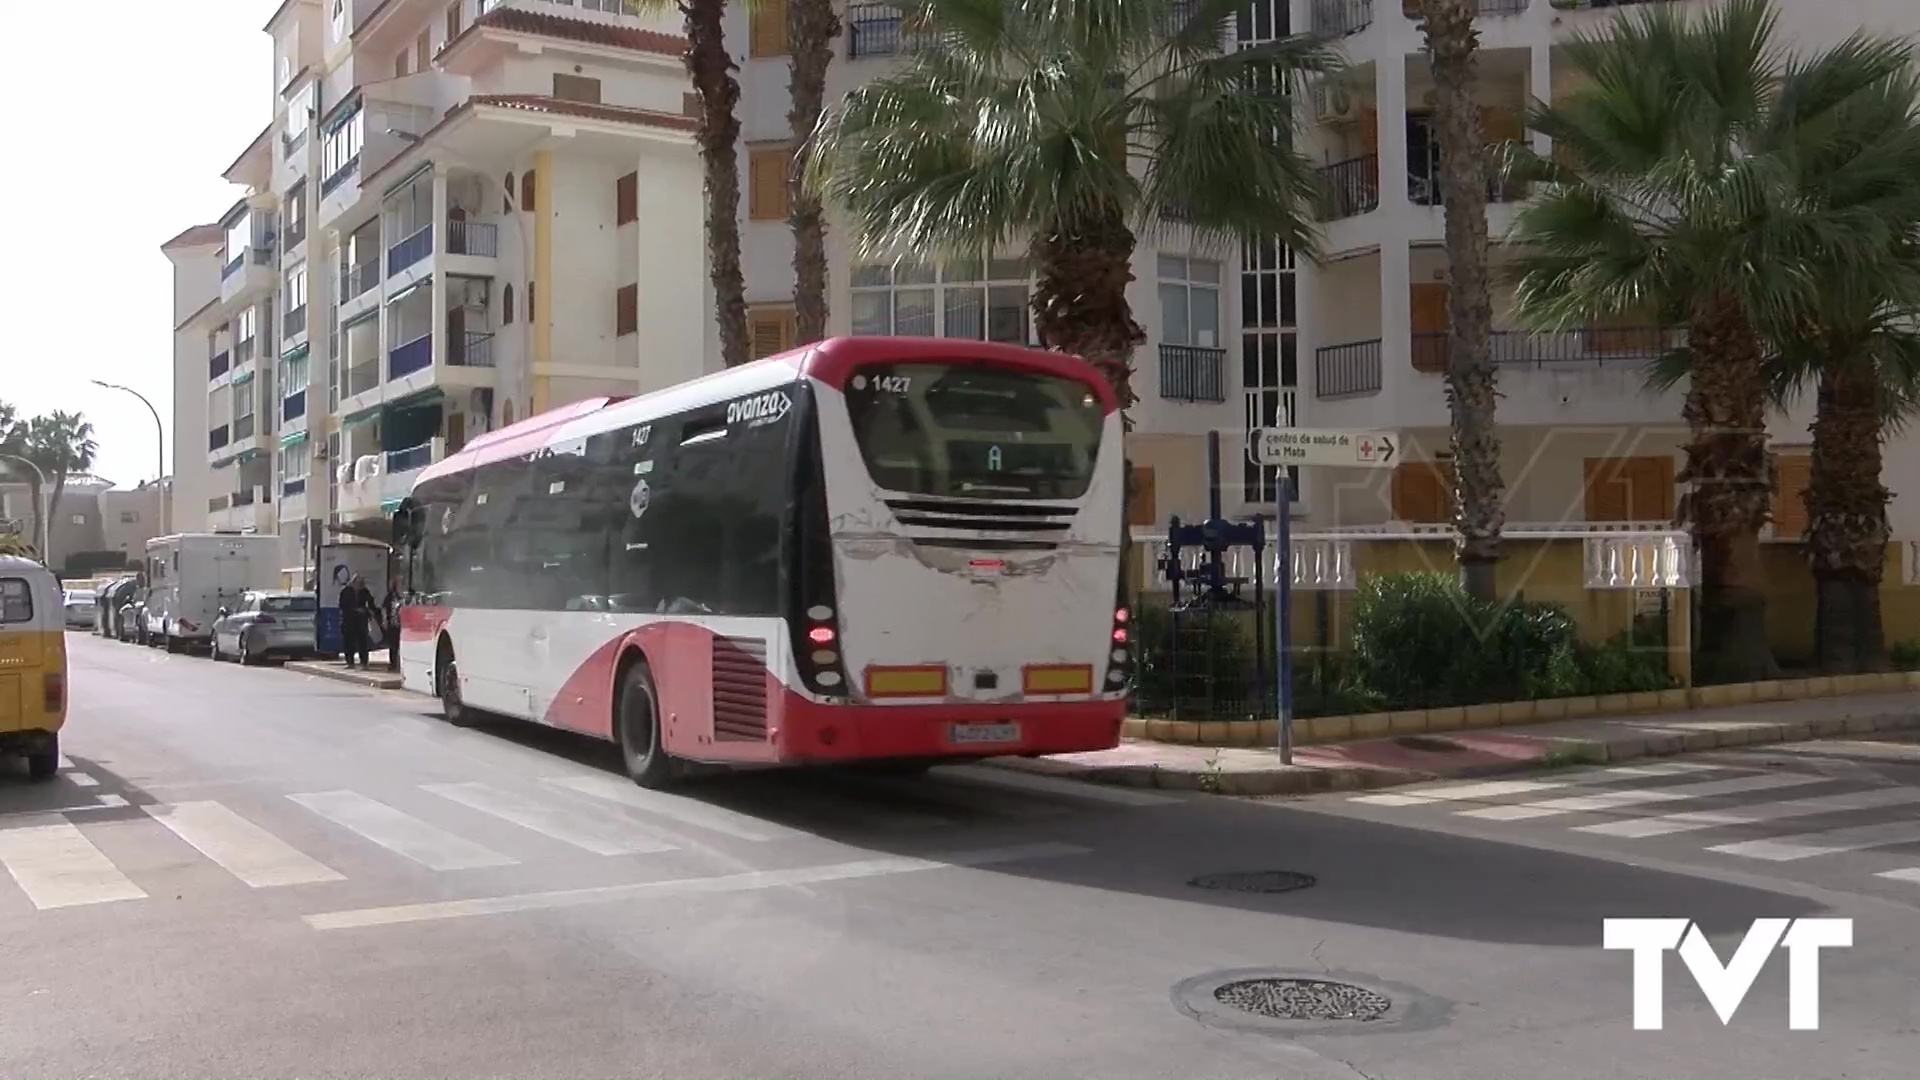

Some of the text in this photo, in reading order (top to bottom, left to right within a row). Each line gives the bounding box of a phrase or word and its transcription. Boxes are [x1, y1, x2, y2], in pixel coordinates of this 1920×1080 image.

[871, 375, 911, 393] 1427
[727, 391, 779, 424] avanza
[632, 425, 652, 447] 1427
[1266, 433, 1349, 446] centro de salud de
[988, 444, 1002, 470] A
[1267, 446, 1306, 457] La Mata
